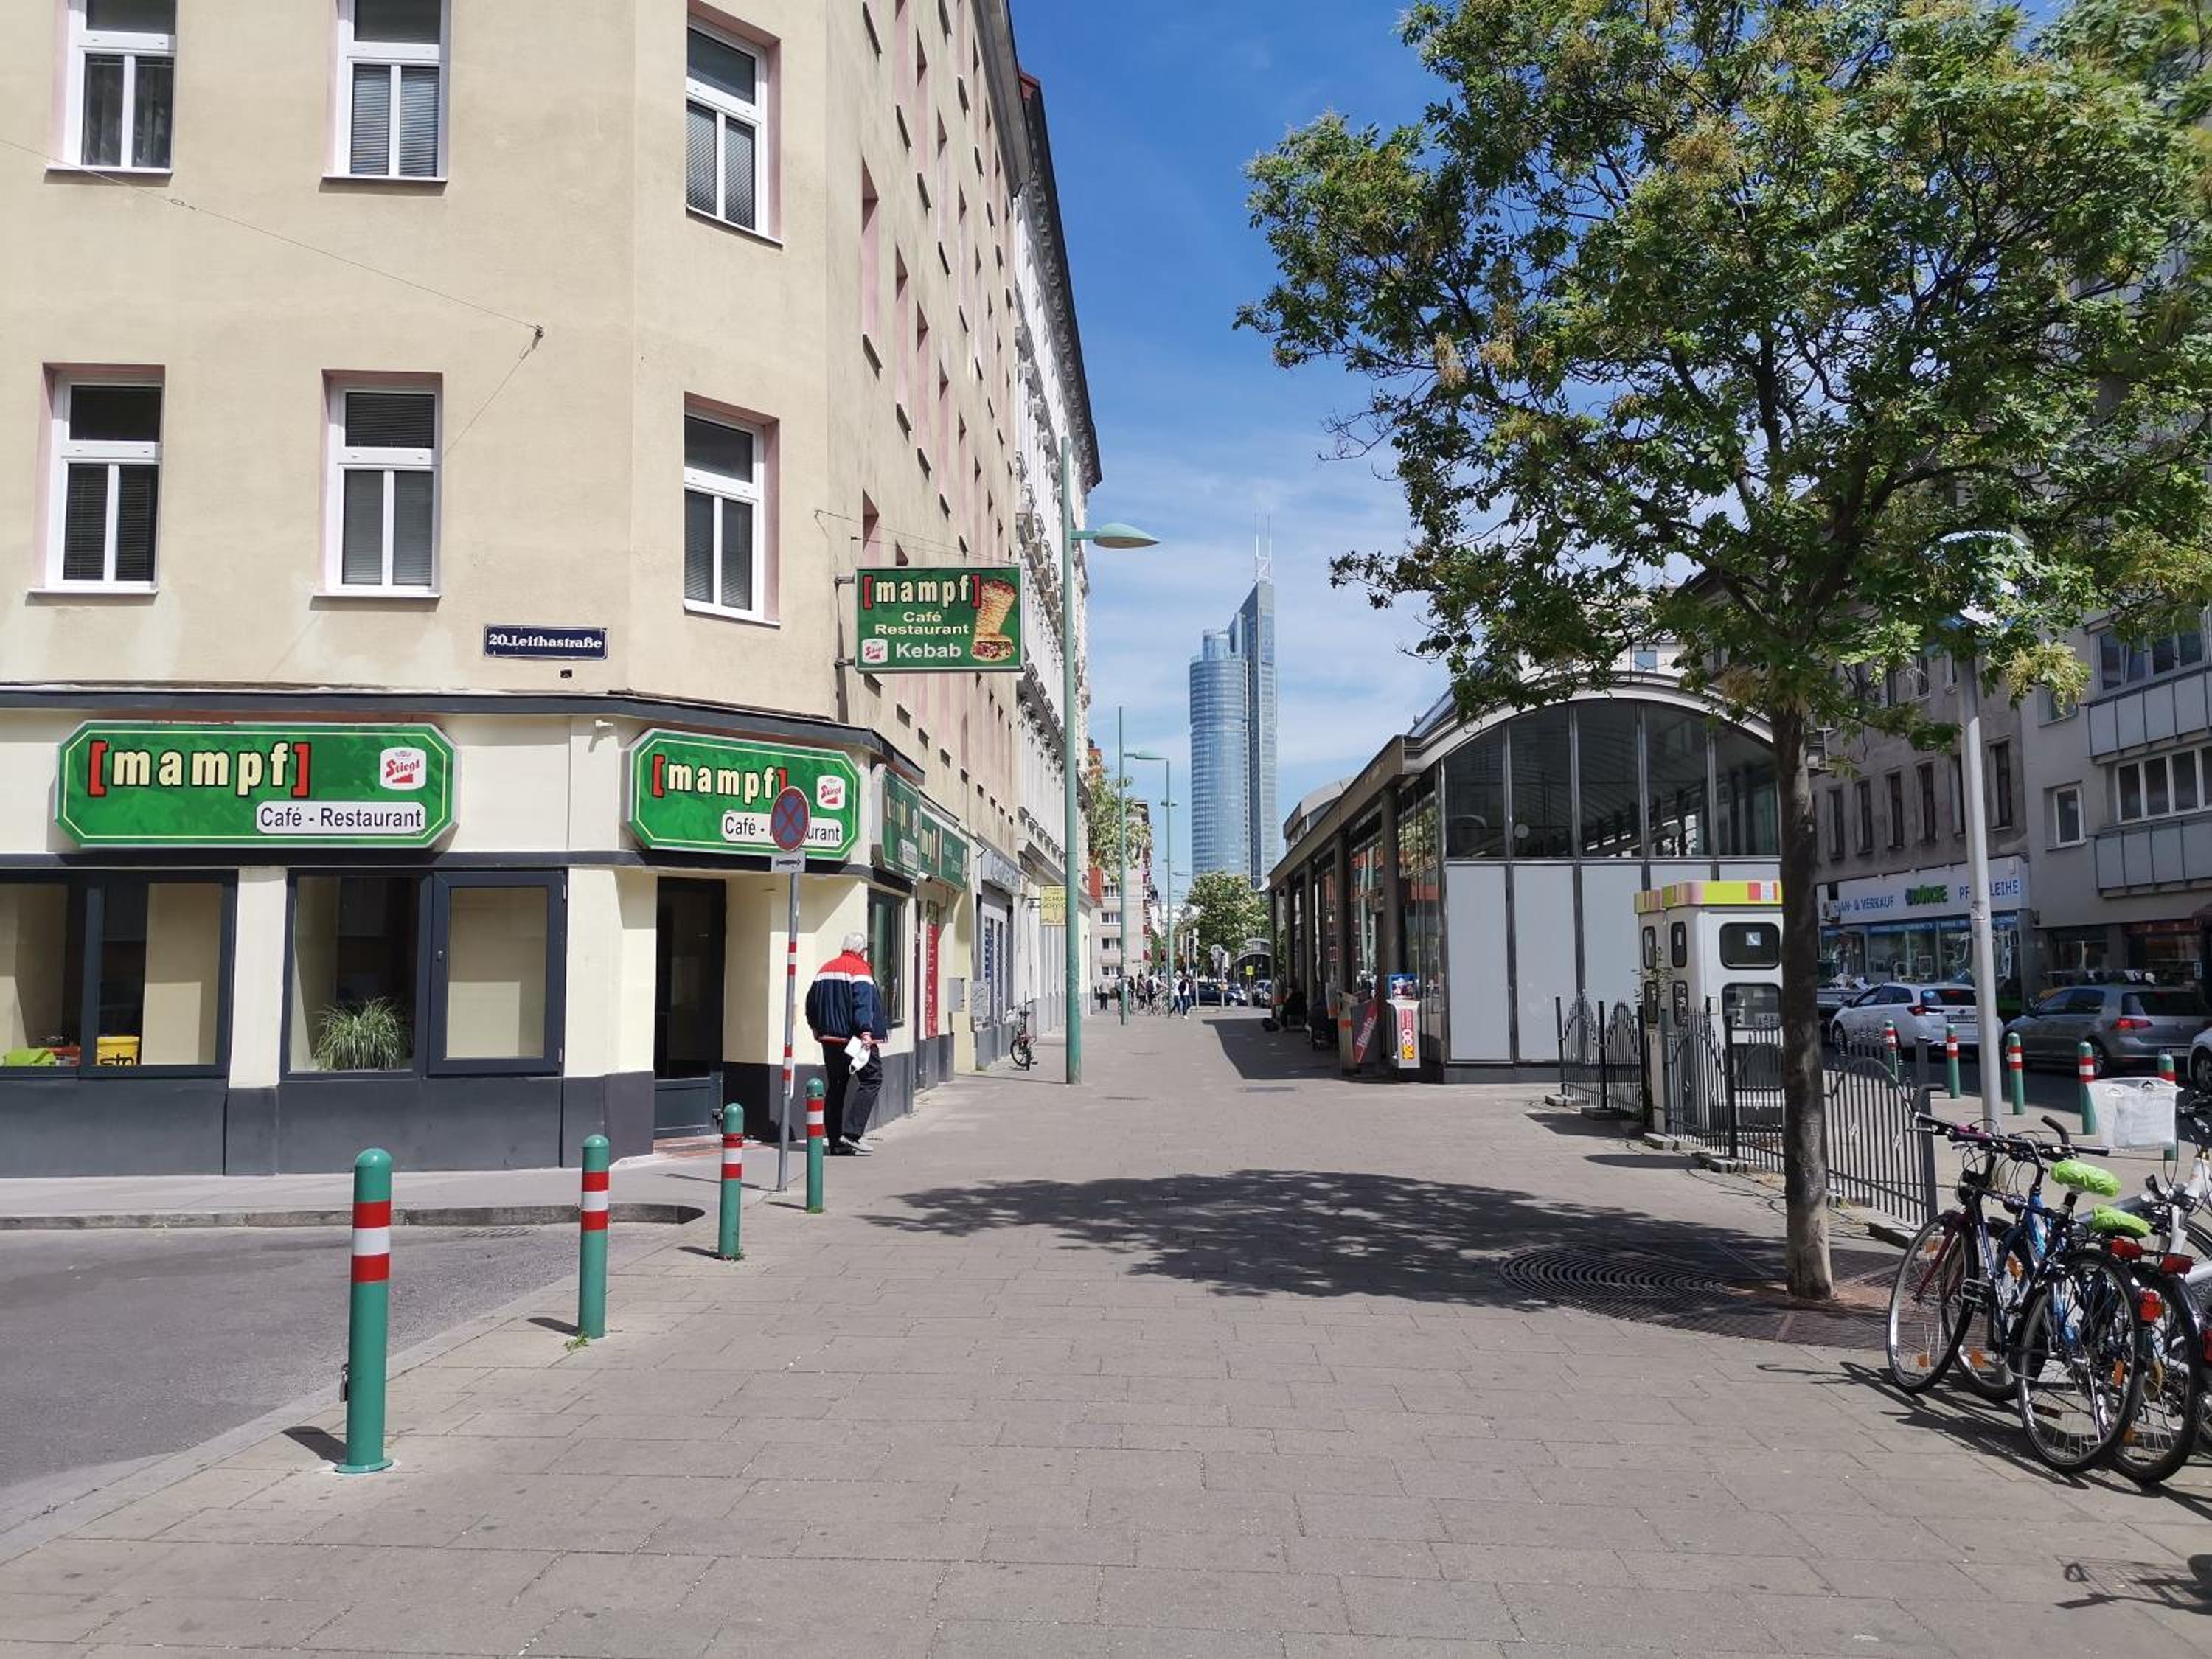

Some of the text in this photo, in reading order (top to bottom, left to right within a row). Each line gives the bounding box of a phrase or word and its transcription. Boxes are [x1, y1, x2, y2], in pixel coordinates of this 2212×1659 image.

[903, 611, 942, 623] Café
[874, 624, 970, 635] Restaurant
[896, 643, 962, 658] Kebab
[385, 759, 420, 778] Stiegl
[260, 806, 302, 828] Café
[320, 807, 422, 828] Restaurant
[724, 815, 757, 837] Café
